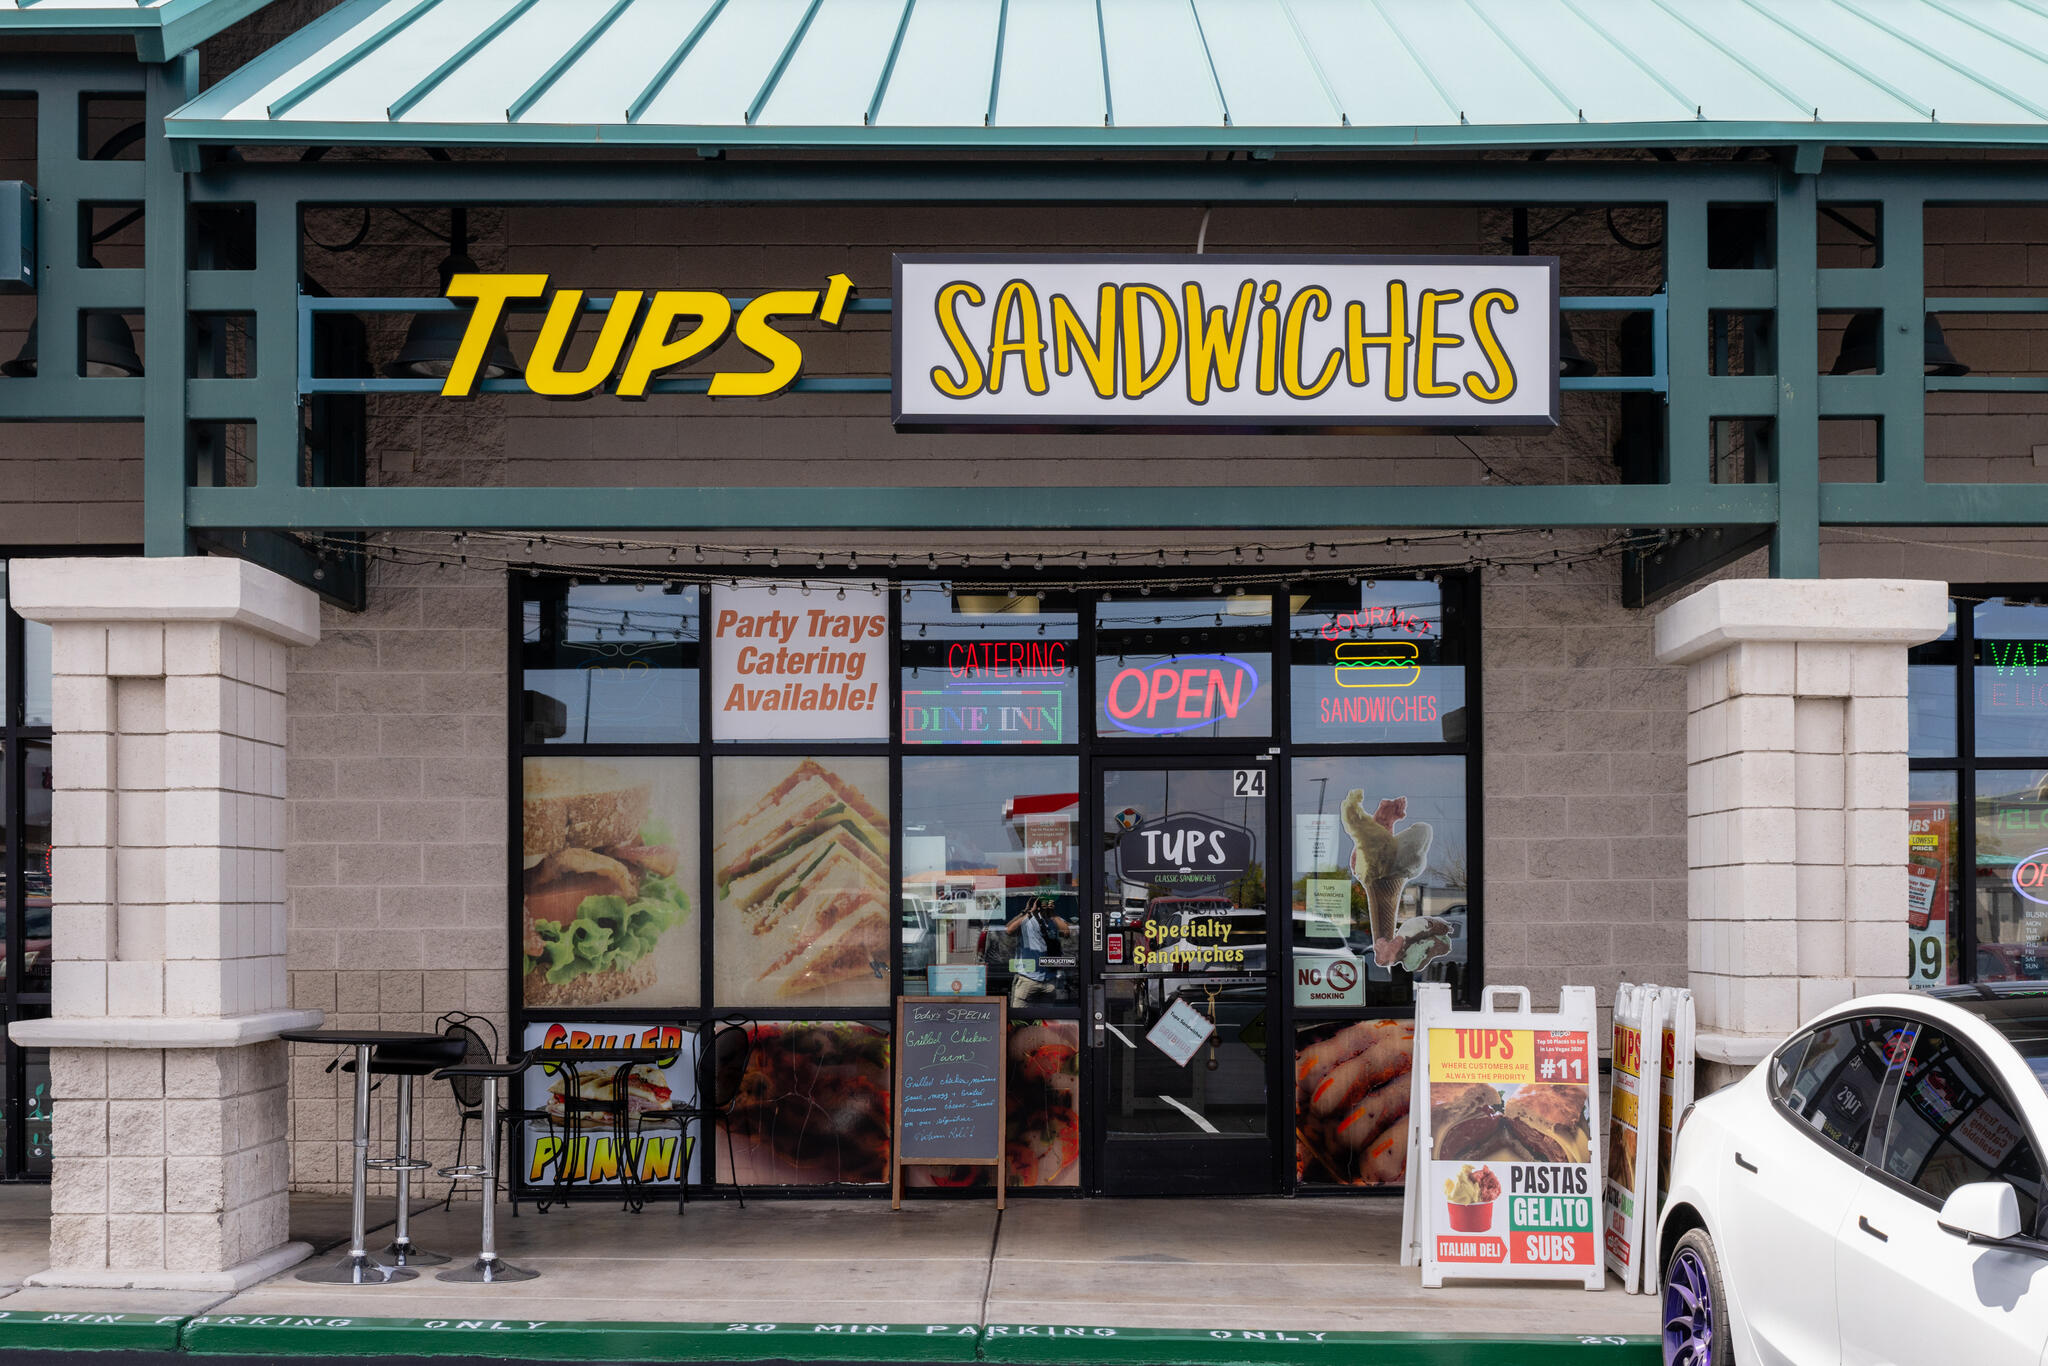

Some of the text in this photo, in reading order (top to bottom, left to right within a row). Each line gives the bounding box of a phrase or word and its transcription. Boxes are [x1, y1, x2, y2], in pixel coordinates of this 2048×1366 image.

[715, 609, 886, 643] Party Trays
[1321, 606, 1433, 641] GOURMET
[736, 646, 866, 680] Catering
[949, 642, 1065, 678] CATERING
[723, 682, 878, 712] Available!
[1107, 668, 1243, 719] OPEN
[904, 706, 1059, 732] DINE INN
[1320, 695, 1437, 724] SANDWICHES
[1235, 771, 1265, 796] 24
[1032, 840, 1063, 855] #11
[1140, 829, 1226, 865] TUPS
[1154, 875, 1179, 883] CLASSIC
[1144, 919, 1232, 945] Specialty
[1133, 945, 1244, 965] Sandwiches
[1298, 968, 1322, 986] NO
[1310, 992, 1345, 1000] SMOKING
[946, 1008, 992, 1021] SPECIAL
[905, 1027, 993, 1047] Grilled Chicken
[1455, 1028, 1514, 1060] TUPS
[1515, 1063, 1529, 1071] ARE
[1540, 1058, 1582, 1080] #11
[1510, 1165, 1588, 1195] PASTAS
[1513, 1197, 1589, 1228] GELATO
[1439, 1241, 1501, 1257] ITALIAN DELI
[1526, 1234, 1576, 1262] SUBS
[41, 1313, 549, 1331] MIN PARKING ONLY
[726, 1322, 1328, 1342] 20 MIN PARKING ONLY
[1576, 1335, 1629, 1346] 20
